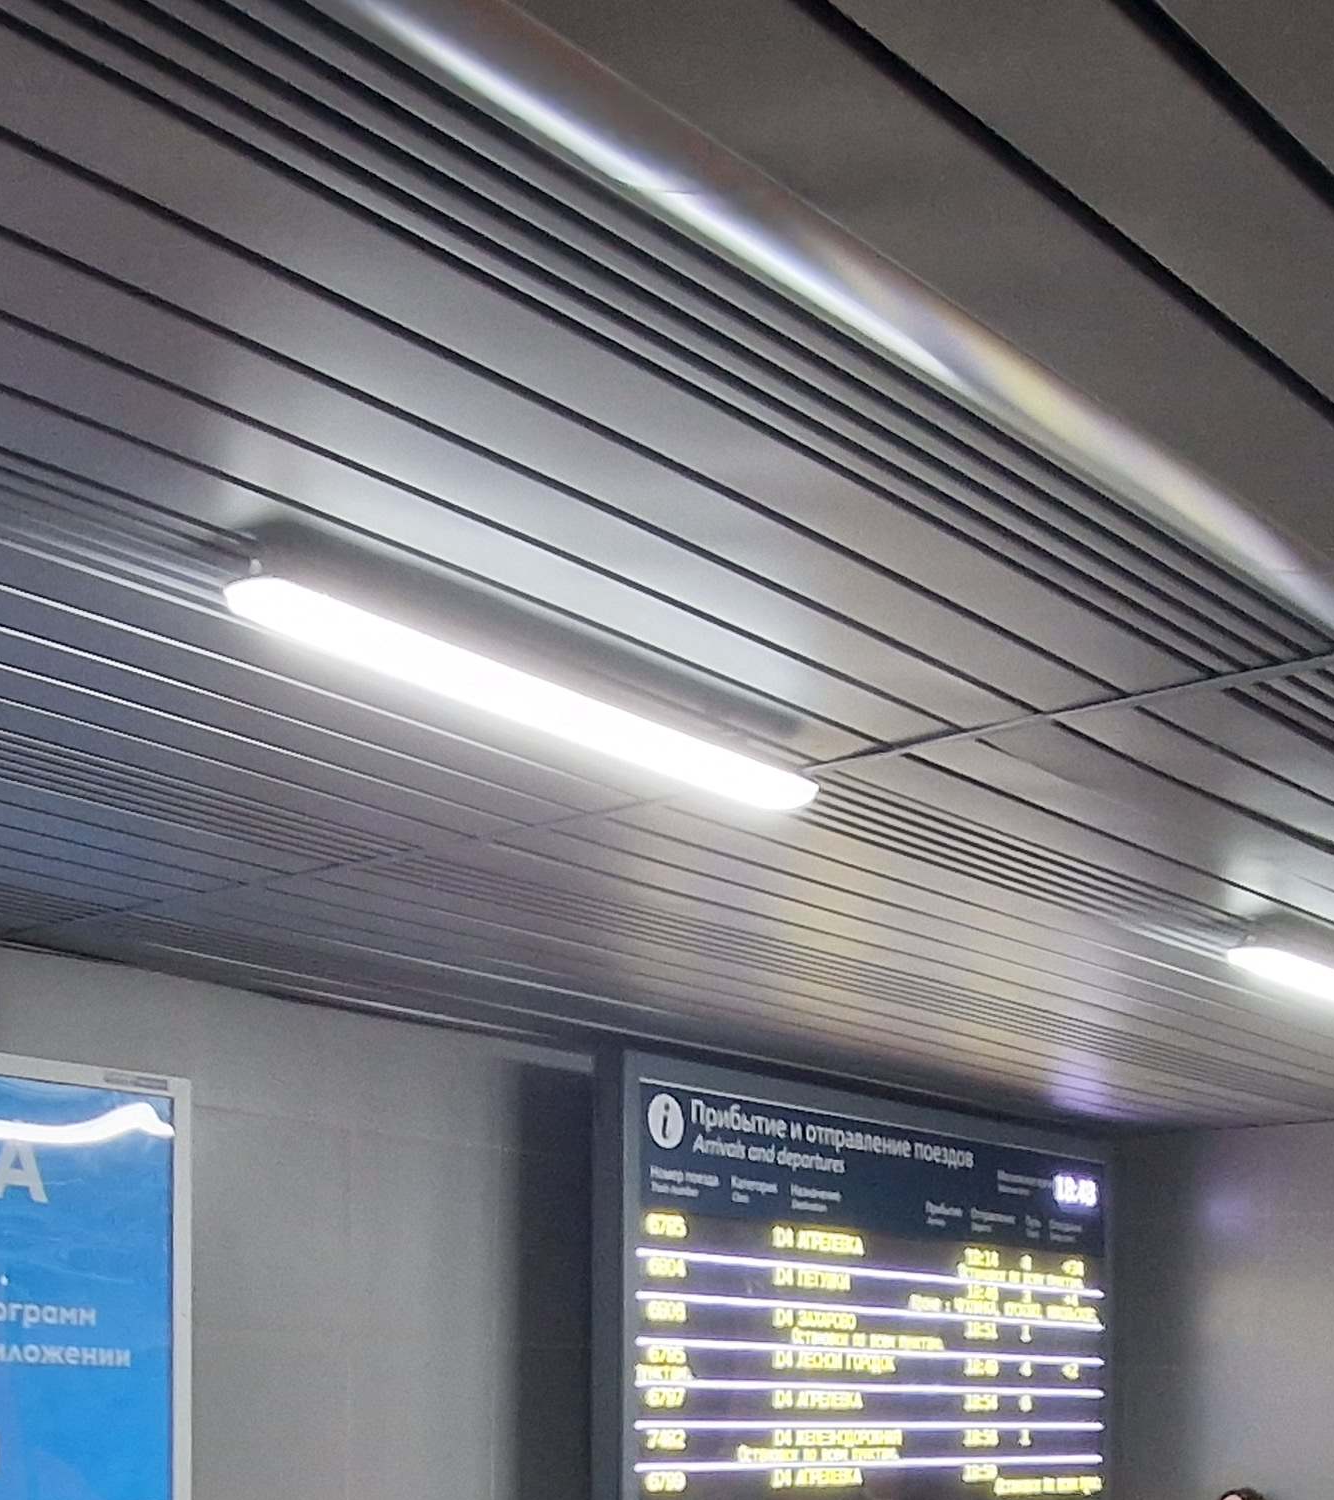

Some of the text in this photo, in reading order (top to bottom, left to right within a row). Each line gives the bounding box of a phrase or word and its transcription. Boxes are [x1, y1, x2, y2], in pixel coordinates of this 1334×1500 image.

[691, 1098, 975, 1170] Прибытие и отправление поездов
[693, 1134, 846, 1173] Arrivals and departures
